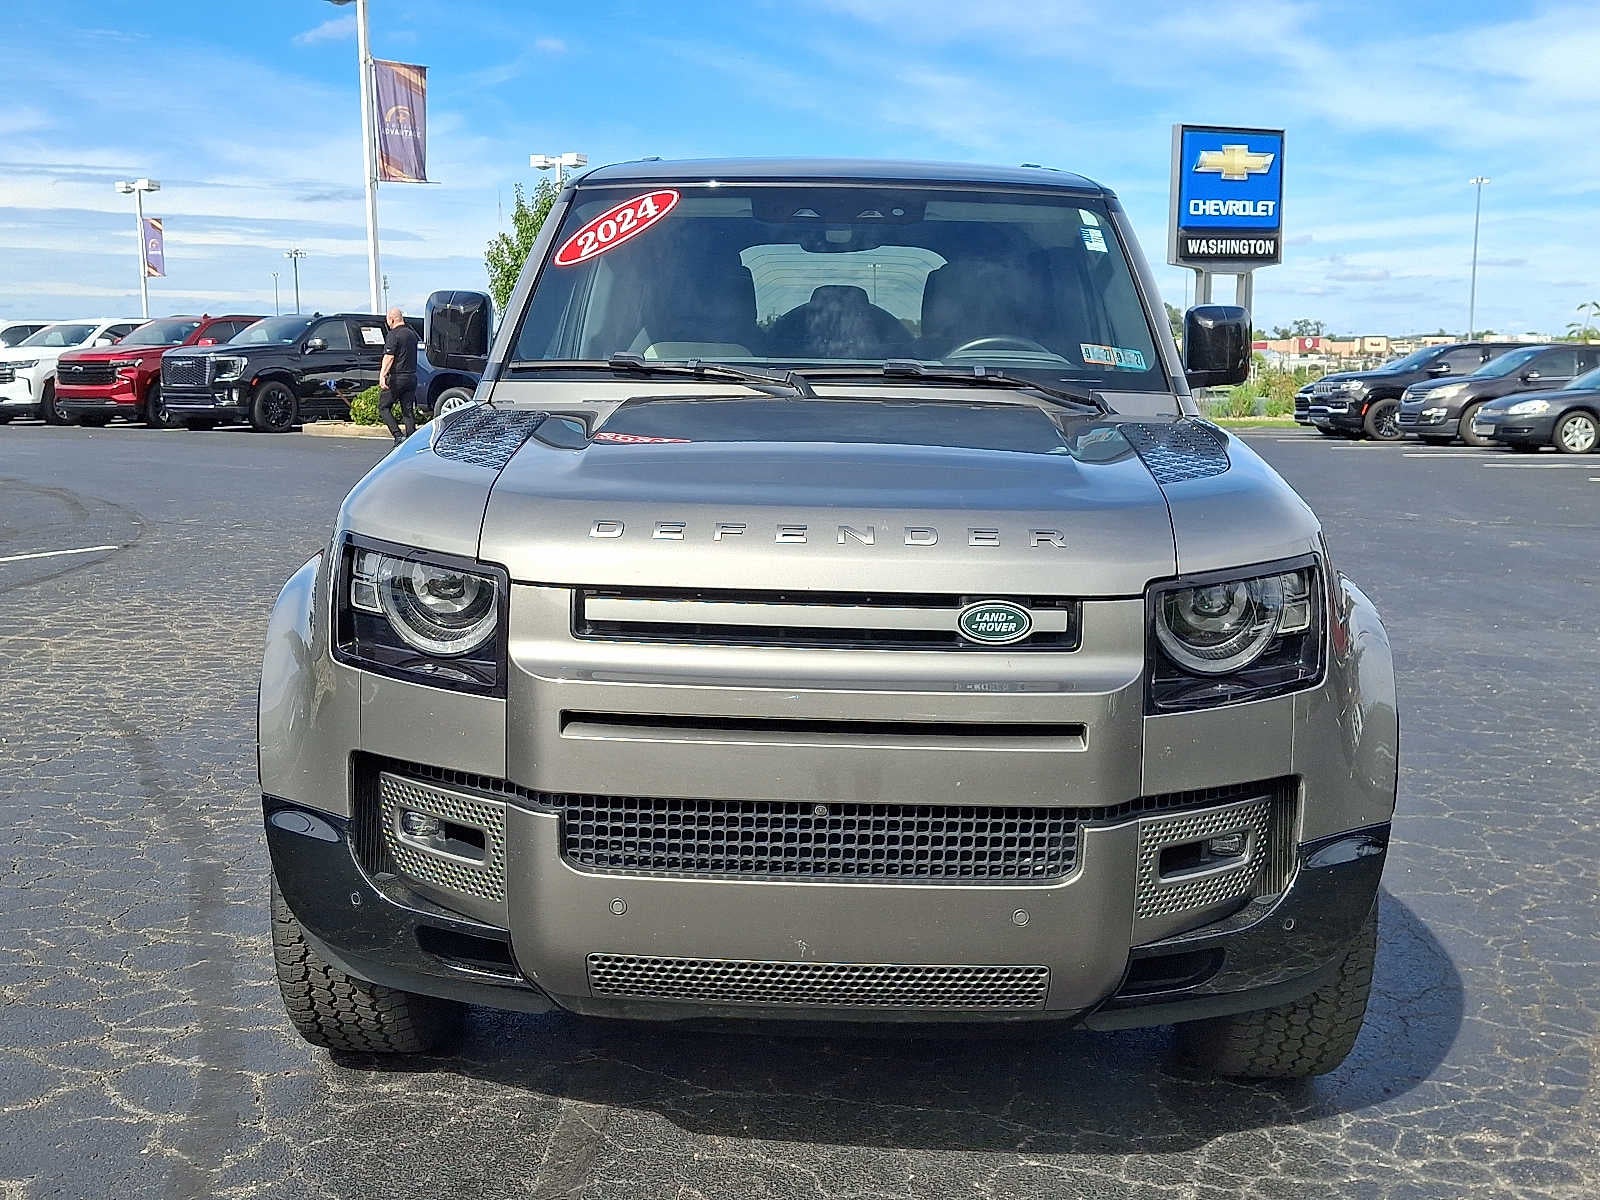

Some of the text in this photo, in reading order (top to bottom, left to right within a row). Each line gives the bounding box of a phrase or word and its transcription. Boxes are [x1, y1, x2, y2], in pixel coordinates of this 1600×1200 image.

[1189, 199, 1276, 217] CHEVROLET
[577, 196, 660, 257] 2024
[1187, 239, 1275, 255] WASHINGTON
[1084, 347, 1092, 359] 9
[588, 519, 1068, 548] DEFENDER
[975, 612, 1007, 622] LAND
[978, 622, 1017, 632] ROVER
